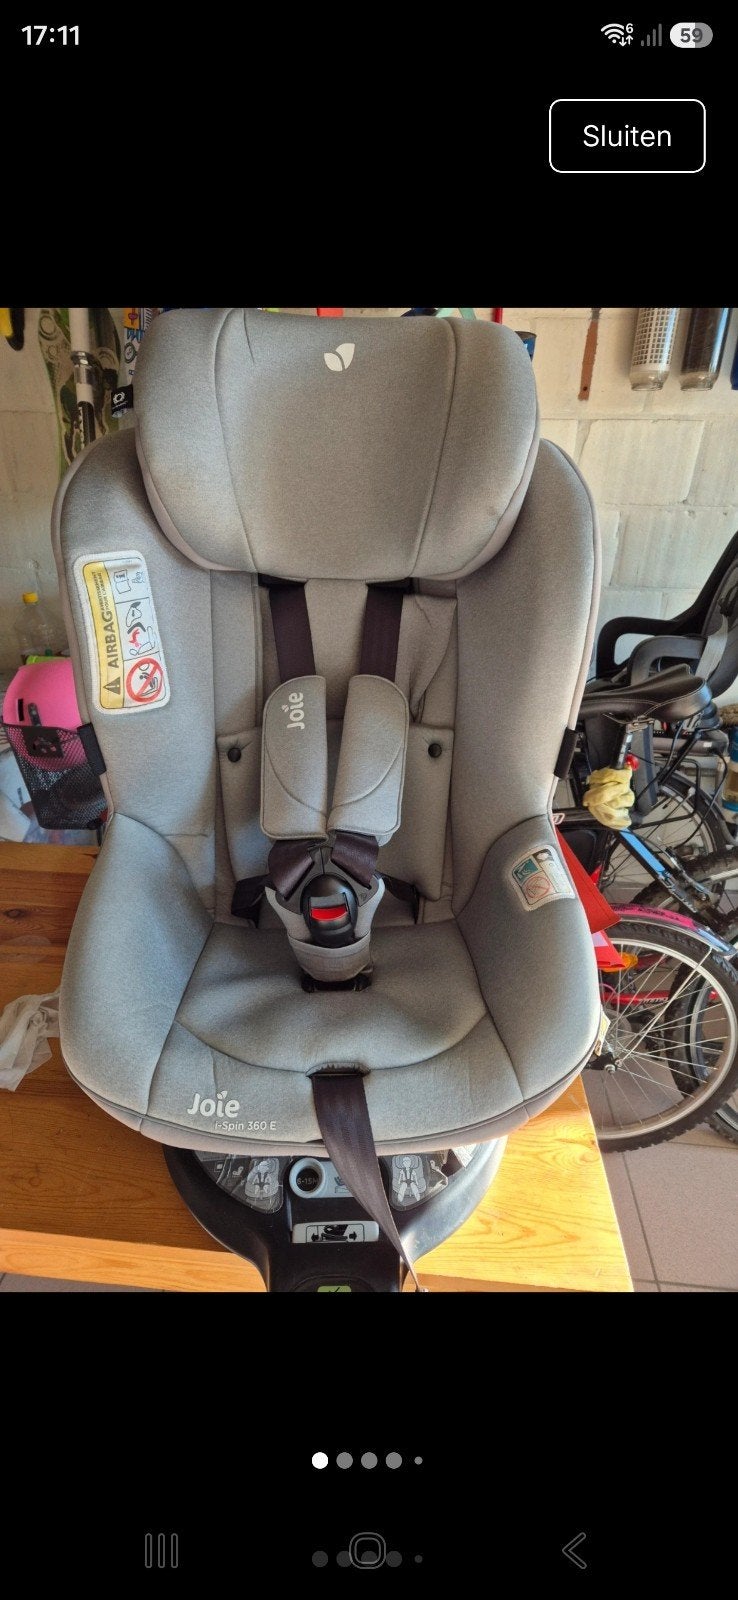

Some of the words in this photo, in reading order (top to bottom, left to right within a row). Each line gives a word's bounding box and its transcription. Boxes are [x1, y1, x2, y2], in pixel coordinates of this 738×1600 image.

[101, 610, 120, 669] AIRBAG
[282, 692, 306, 730] Joie
[186, 1090, 240, 1118] Joie
[214, 1121, 244, 1132] i-Spin
[247, 1121, 267, 1131] 360
[269, 1121, 277, 1131] E
